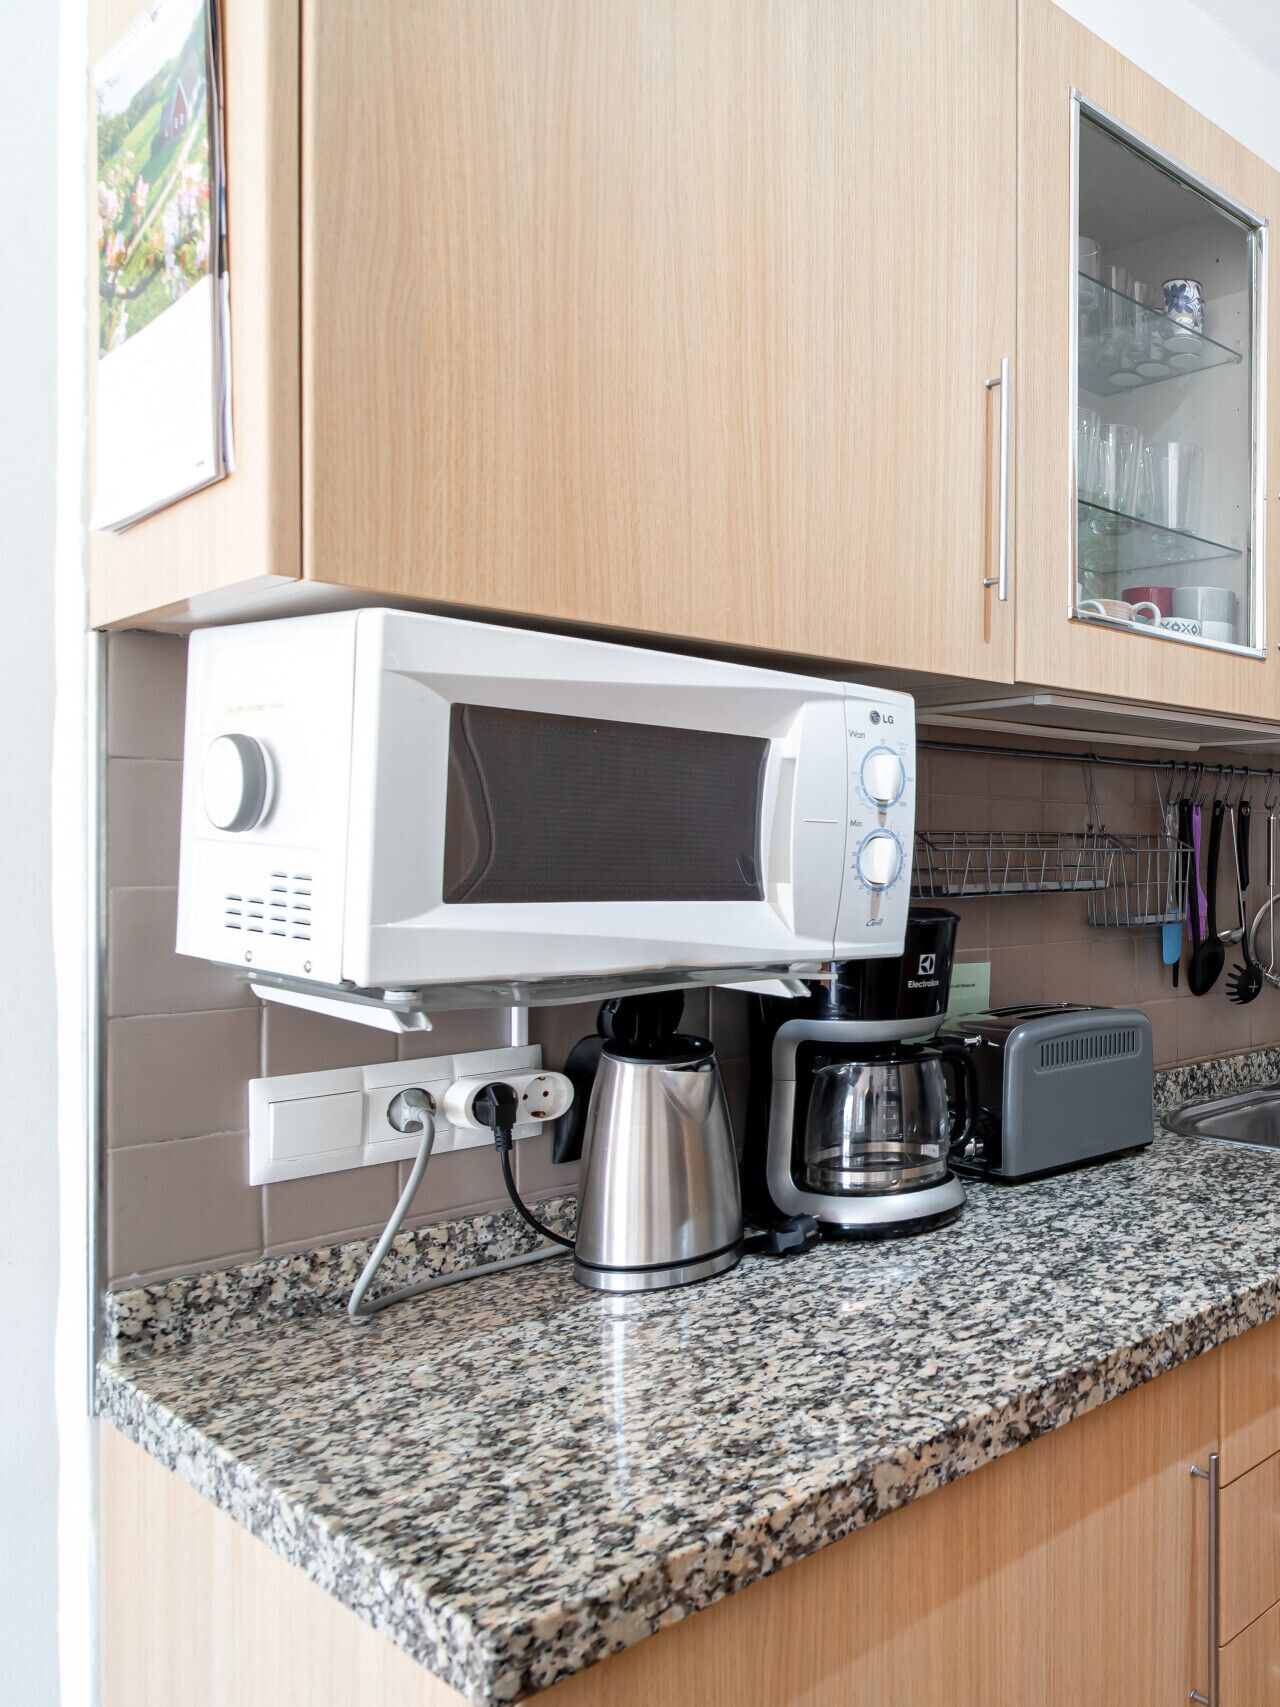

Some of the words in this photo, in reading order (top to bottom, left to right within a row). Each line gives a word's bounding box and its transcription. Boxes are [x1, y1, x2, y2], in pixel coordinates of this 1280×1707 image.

[882, 715, 894, 725] LG
[847, 728, 866, 740] Watt
[849, 819, 863, 828] Min
[866, 917, 884, 927] Grill
[907, 978, 940, 989] Electrolux
